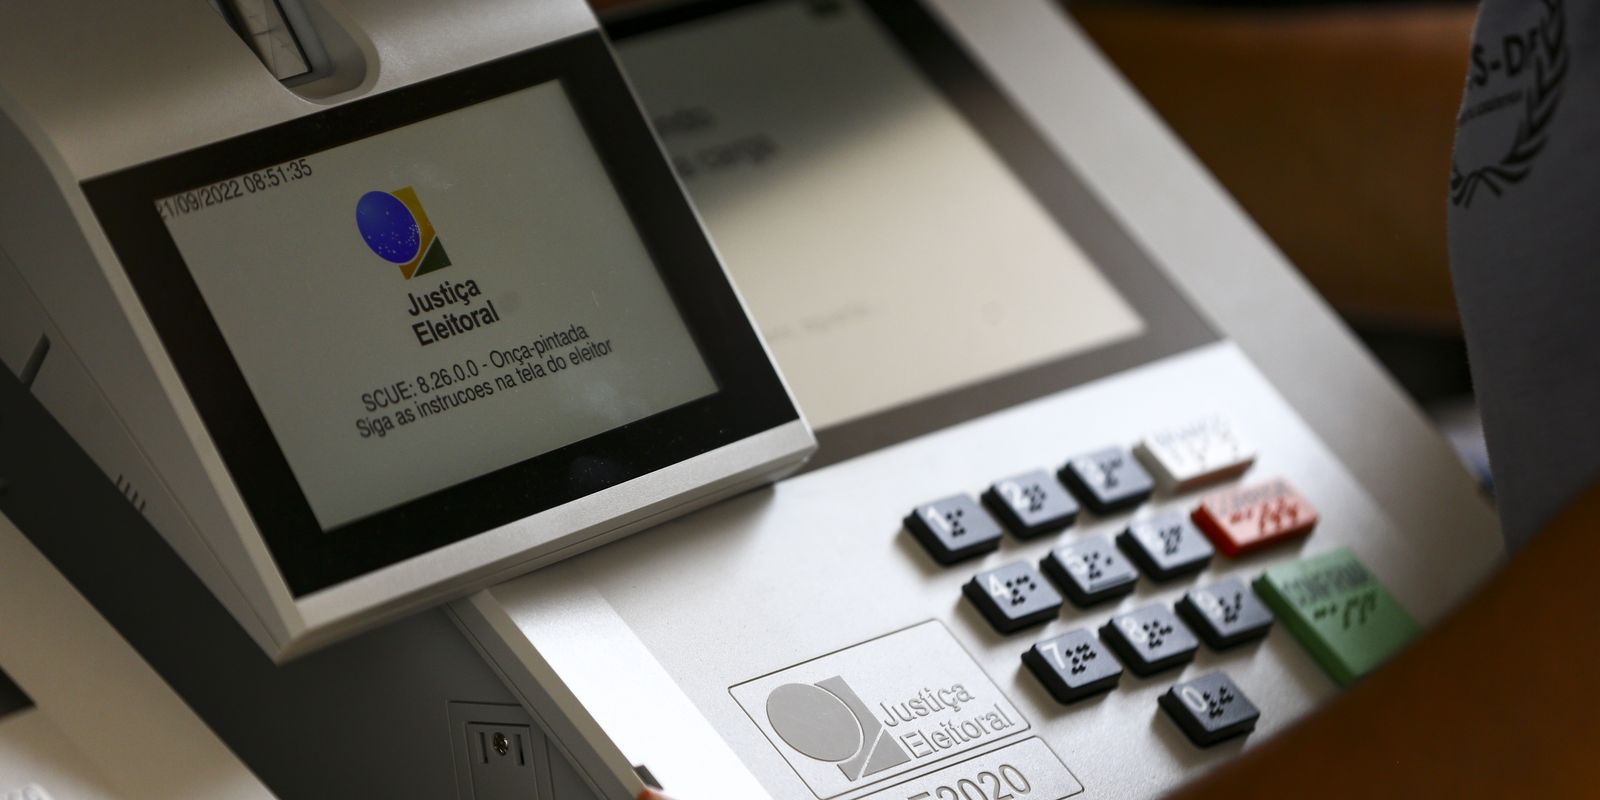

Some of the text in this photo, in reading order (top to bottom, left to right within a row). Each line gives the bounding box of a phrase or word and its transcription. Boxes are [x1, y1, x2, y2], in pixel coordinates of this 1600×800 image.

[158, 158, 313, 219] 21/09/2022 08:51:35
[407, 278, 481, 316] Justiça
[411, 299, 500, 347] Eleitoral
[355, 336, 613, 439] Siga as instrucoes na tela do eleitor
[361, 379, 417, 412] SCUE:
[416, 359, 479, 394] 8.26.0.0
[489, 323, 589, 369] Onça-pintada
[1121, 616, 1148, 644] 8
[1042, 642, 1067, 669] 7
[881, 680, 976, 728] Justiça
[1181, 685, 1209, 713] 0
[899, 704, 1017, 759] Eleitoral
[907, 763, 1032, 800] 020
